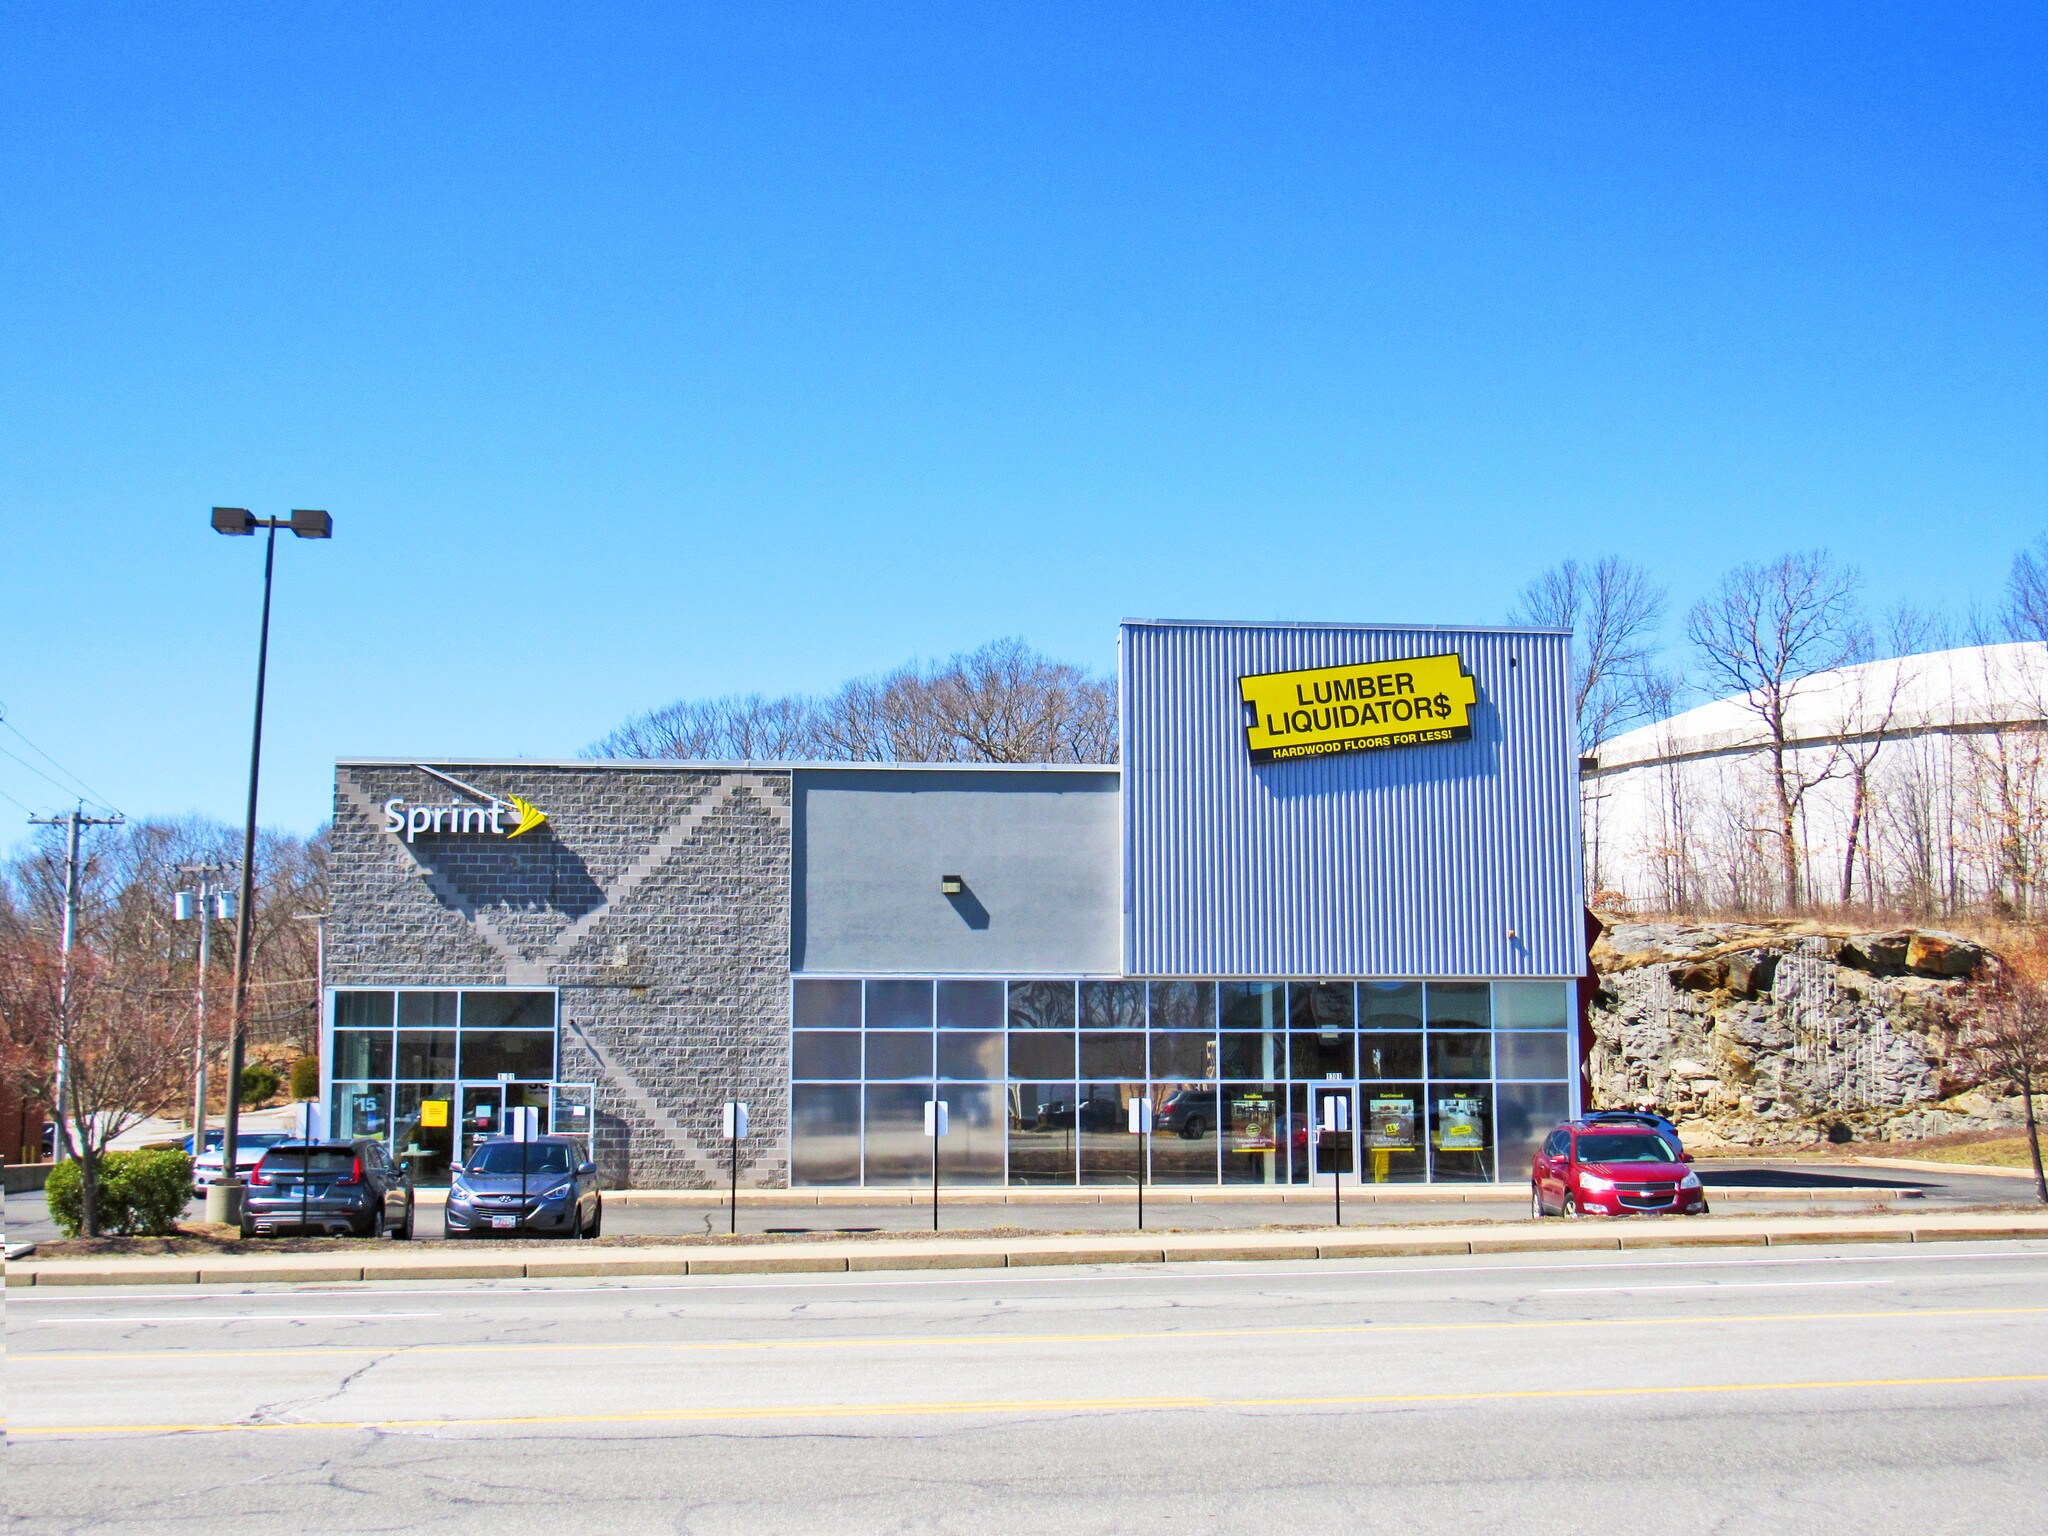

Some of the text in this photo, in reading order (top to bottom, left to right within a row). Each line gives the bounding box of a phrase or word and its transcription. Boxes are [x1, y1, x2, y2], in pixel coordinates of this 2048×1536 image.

[1296, 672, 1415, 706] LUMBER
[1266, 692, 1452, 736] LIQUIDATOR$
[1272, 730, 1452, 759] HARDWOOD FLOORS FOR LESS!
[384, 798, 505, 843] Sprint
